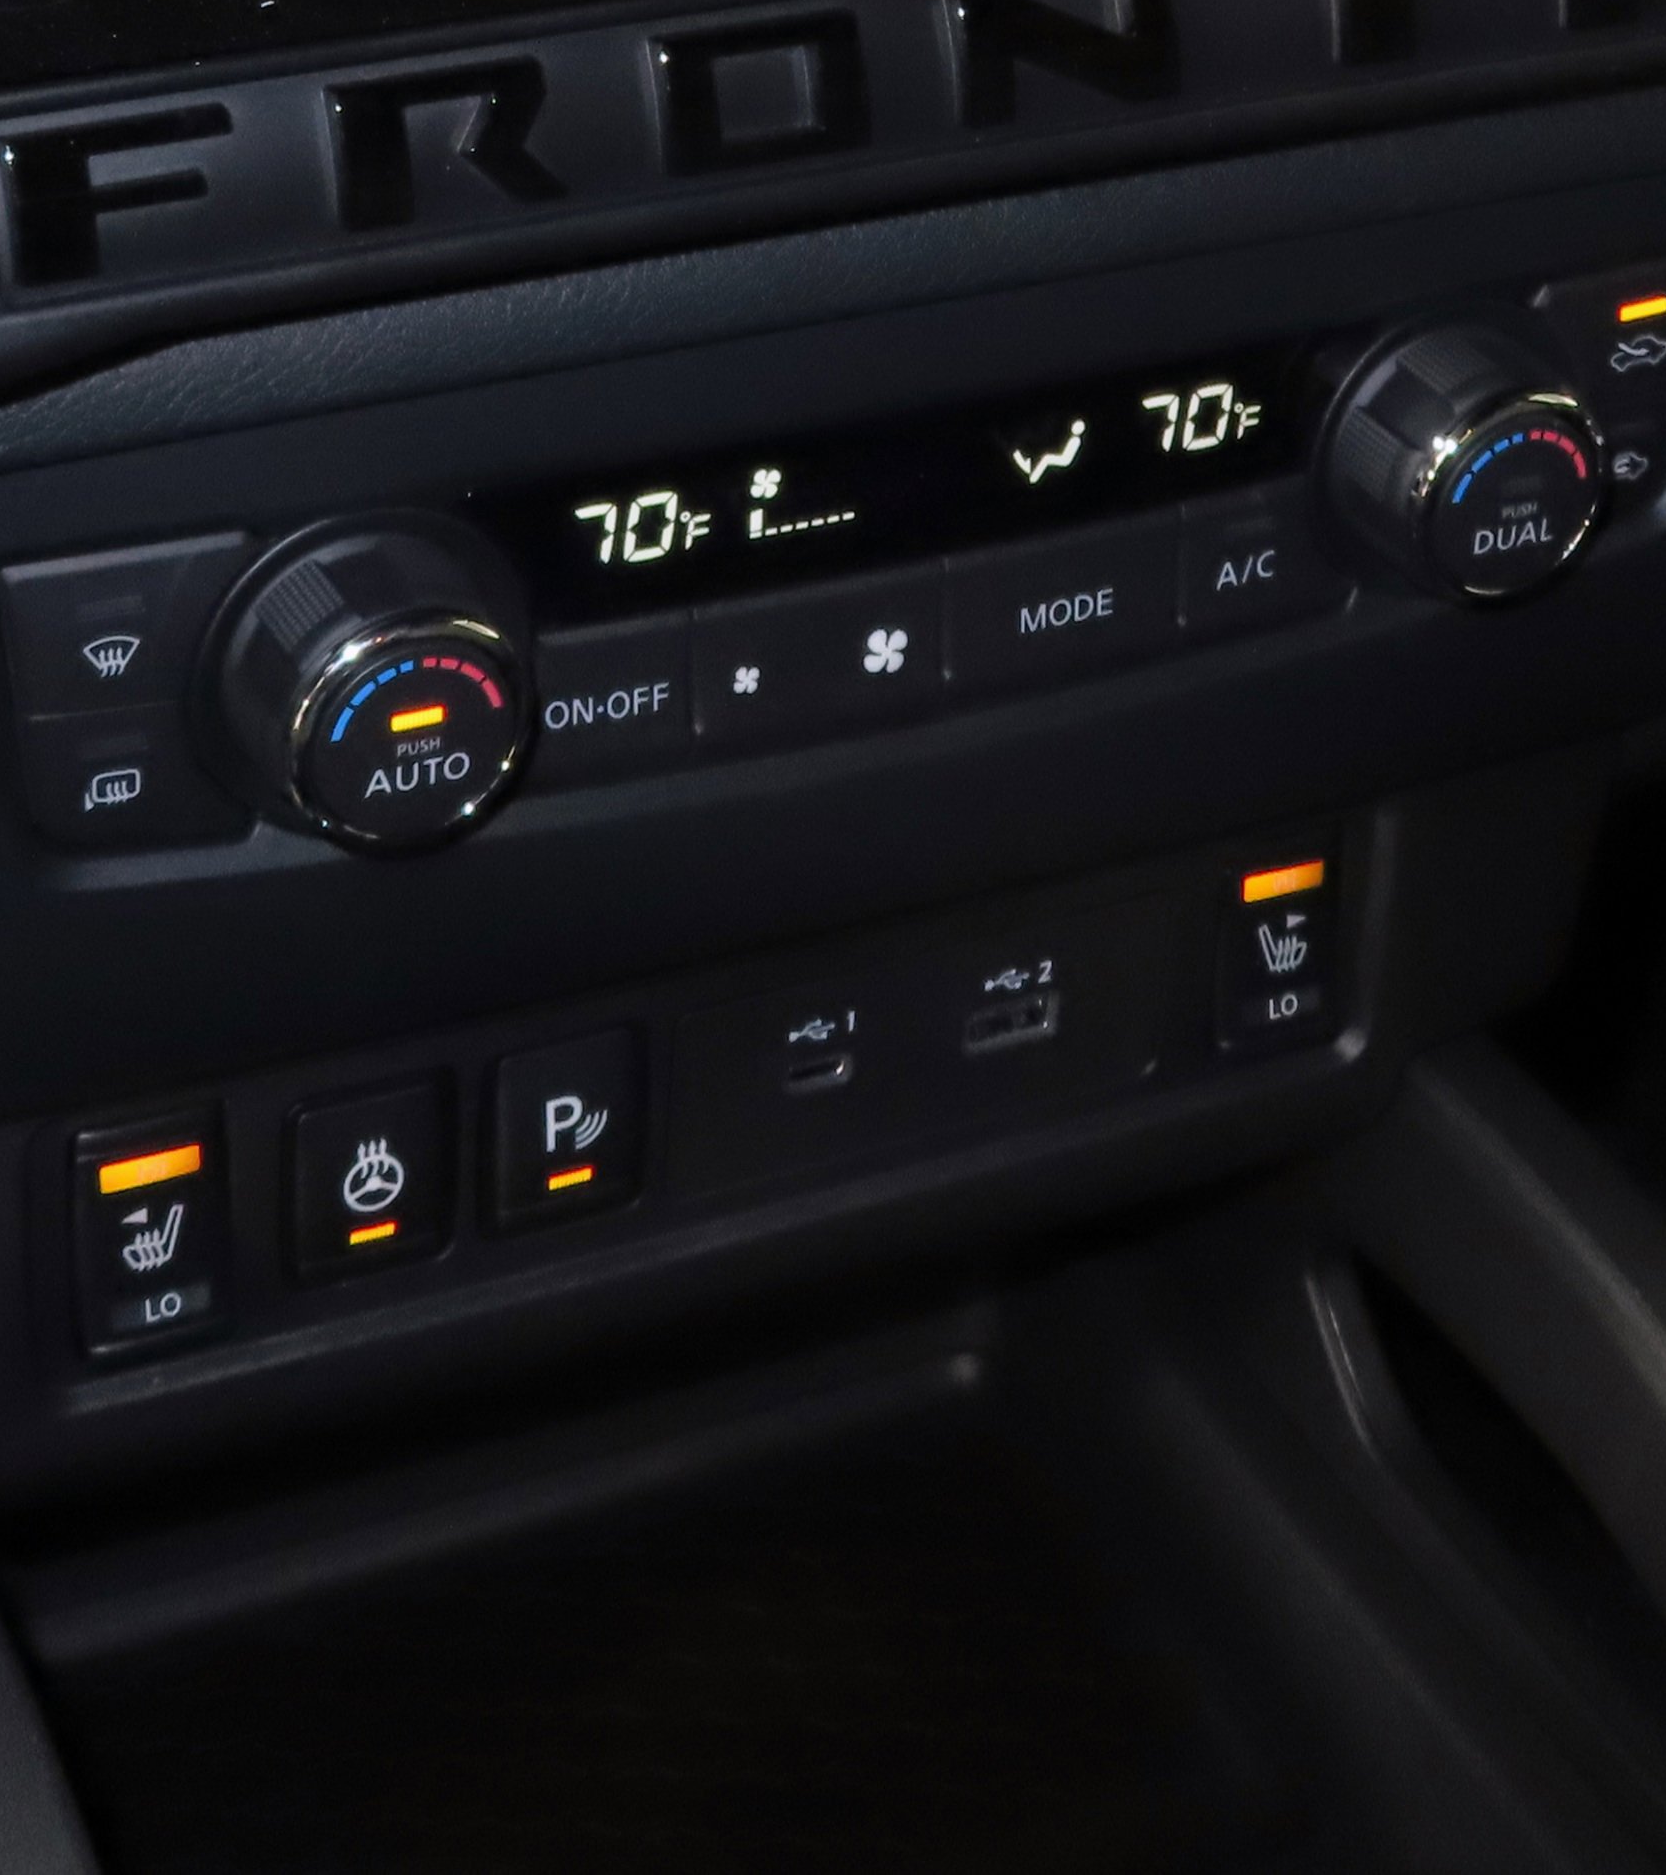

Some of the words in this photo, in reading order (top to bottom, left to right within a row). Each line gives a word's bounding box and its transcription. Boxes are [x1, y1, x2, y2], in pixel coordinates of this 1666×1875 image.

[1473, 517, 1552, 555] DUAL
[1216, 549, 1275, 591] A/C
[1020, 588, 1113, 634] MODE
[396, 736, 441, 758] PUSH
[364, 746, 470, 799] AUTO
[1038, 960, 1053, 984] 2
[847, 1010, 855, 1032] 1
[1268, 993, 1299, 1020] LO
[144, 1292, 182, 1323] LO
